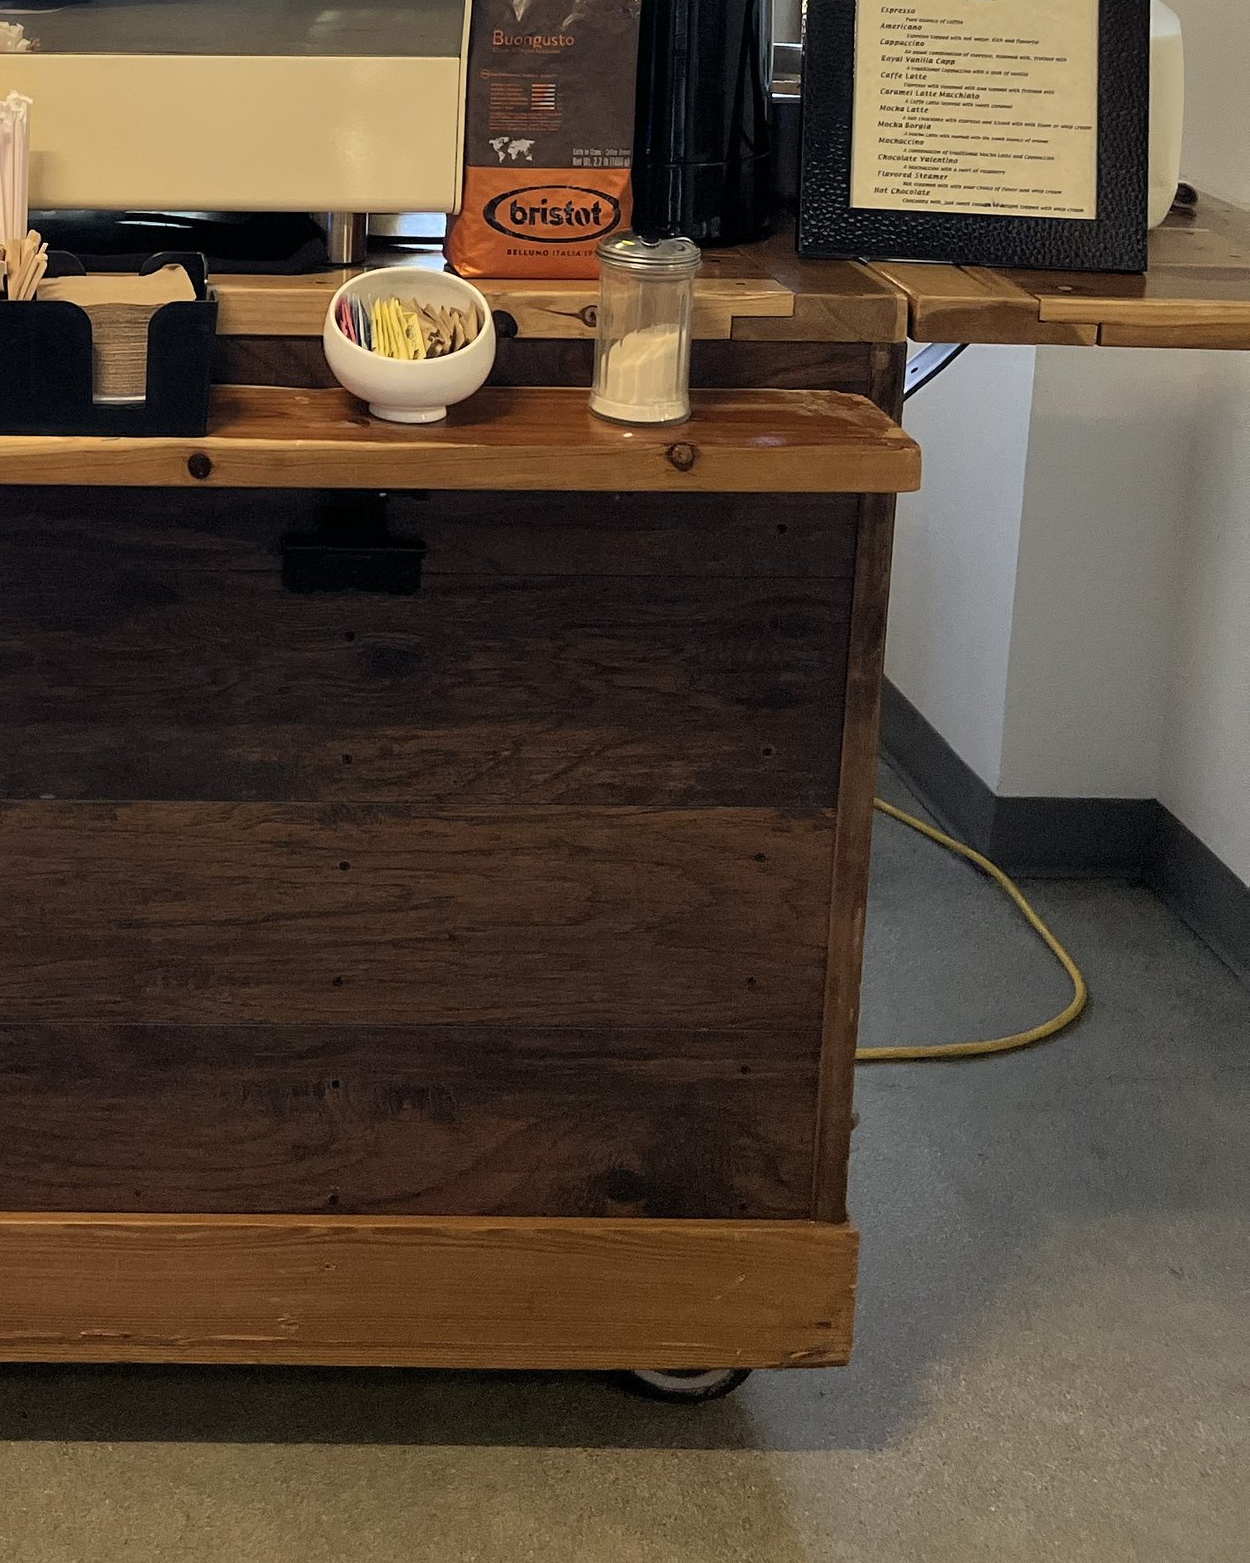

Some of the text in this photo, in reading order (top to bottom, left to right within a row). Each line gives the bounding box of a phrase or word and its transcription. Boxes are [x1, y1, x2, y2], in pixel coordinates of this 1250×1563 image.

[493, 29, 575, 49] Buongusto
[880, 39, 925, 47] Cappuccino
[881, 55, 903, 63] Royal
[936, 58, 956, 66] Capp
[906, 73, 927, 81] Latte
[880, 88, 913, 96] Caramel
[939, 91, 980, 100] Macchiato
[878, 121, 903, 129] Mocha
[879, 138, 925, 146] Mochaccino
[878, 154, 959, 164] Chocolate Valentino
[878, 171, 912, 179] Flavored
[891, 188, 930, 196] Chocolate
[510, 198, 602, 227] bristot
[553, 249, 581, 257] ITALIA
[584, 249, 594, 257] 19
